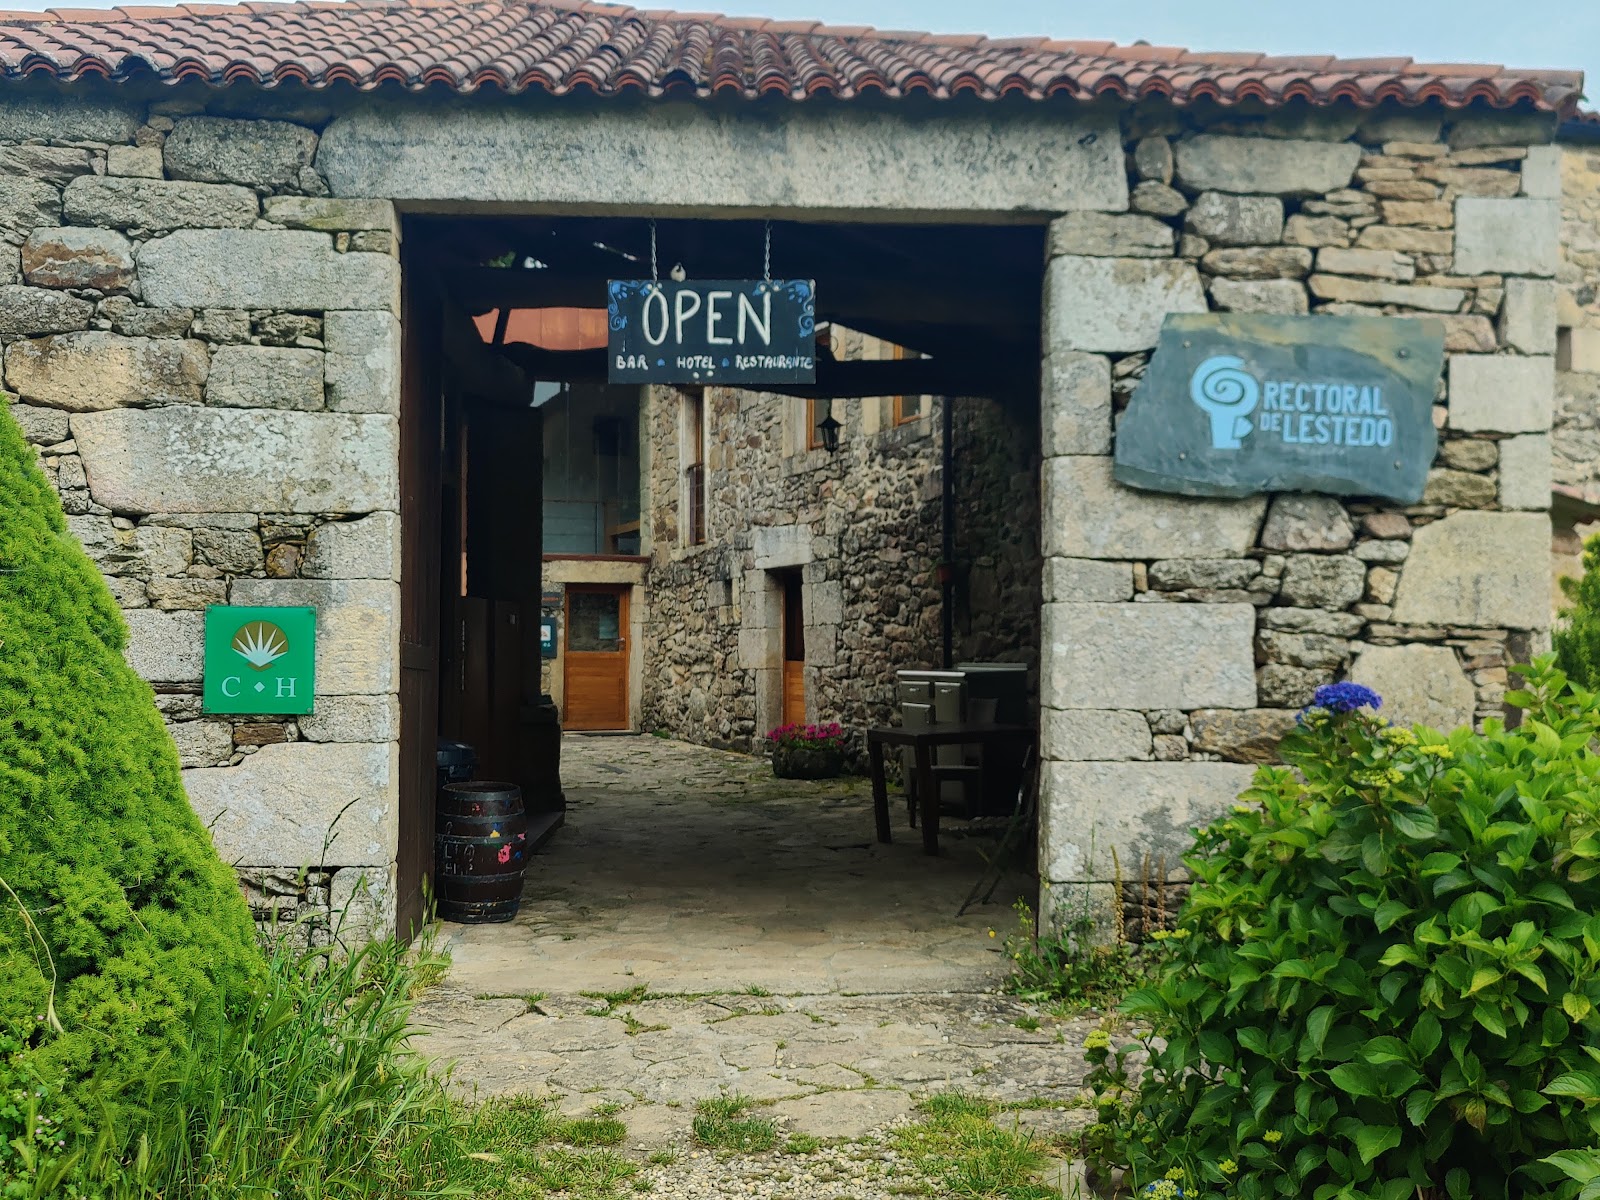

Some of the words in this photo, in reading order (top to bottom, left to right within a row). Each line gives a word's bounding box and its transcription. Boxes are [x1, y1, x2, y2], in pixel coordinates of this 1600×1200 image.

[642, 289, 771, 346] OPEN
[616, 355, 648, 369] BAR
[676, 355, 716, 370] HOTEL
[735, 354, 813, 370] RESTAURANTE
[1264, 381, 1388, 415] RECTORAL
[1260, 411, 1281, 432] DE
[1283, 414, 1392, 447] LESTEDO
[221, 676, 241, 698] C
[275, 676, 297, 698] H
